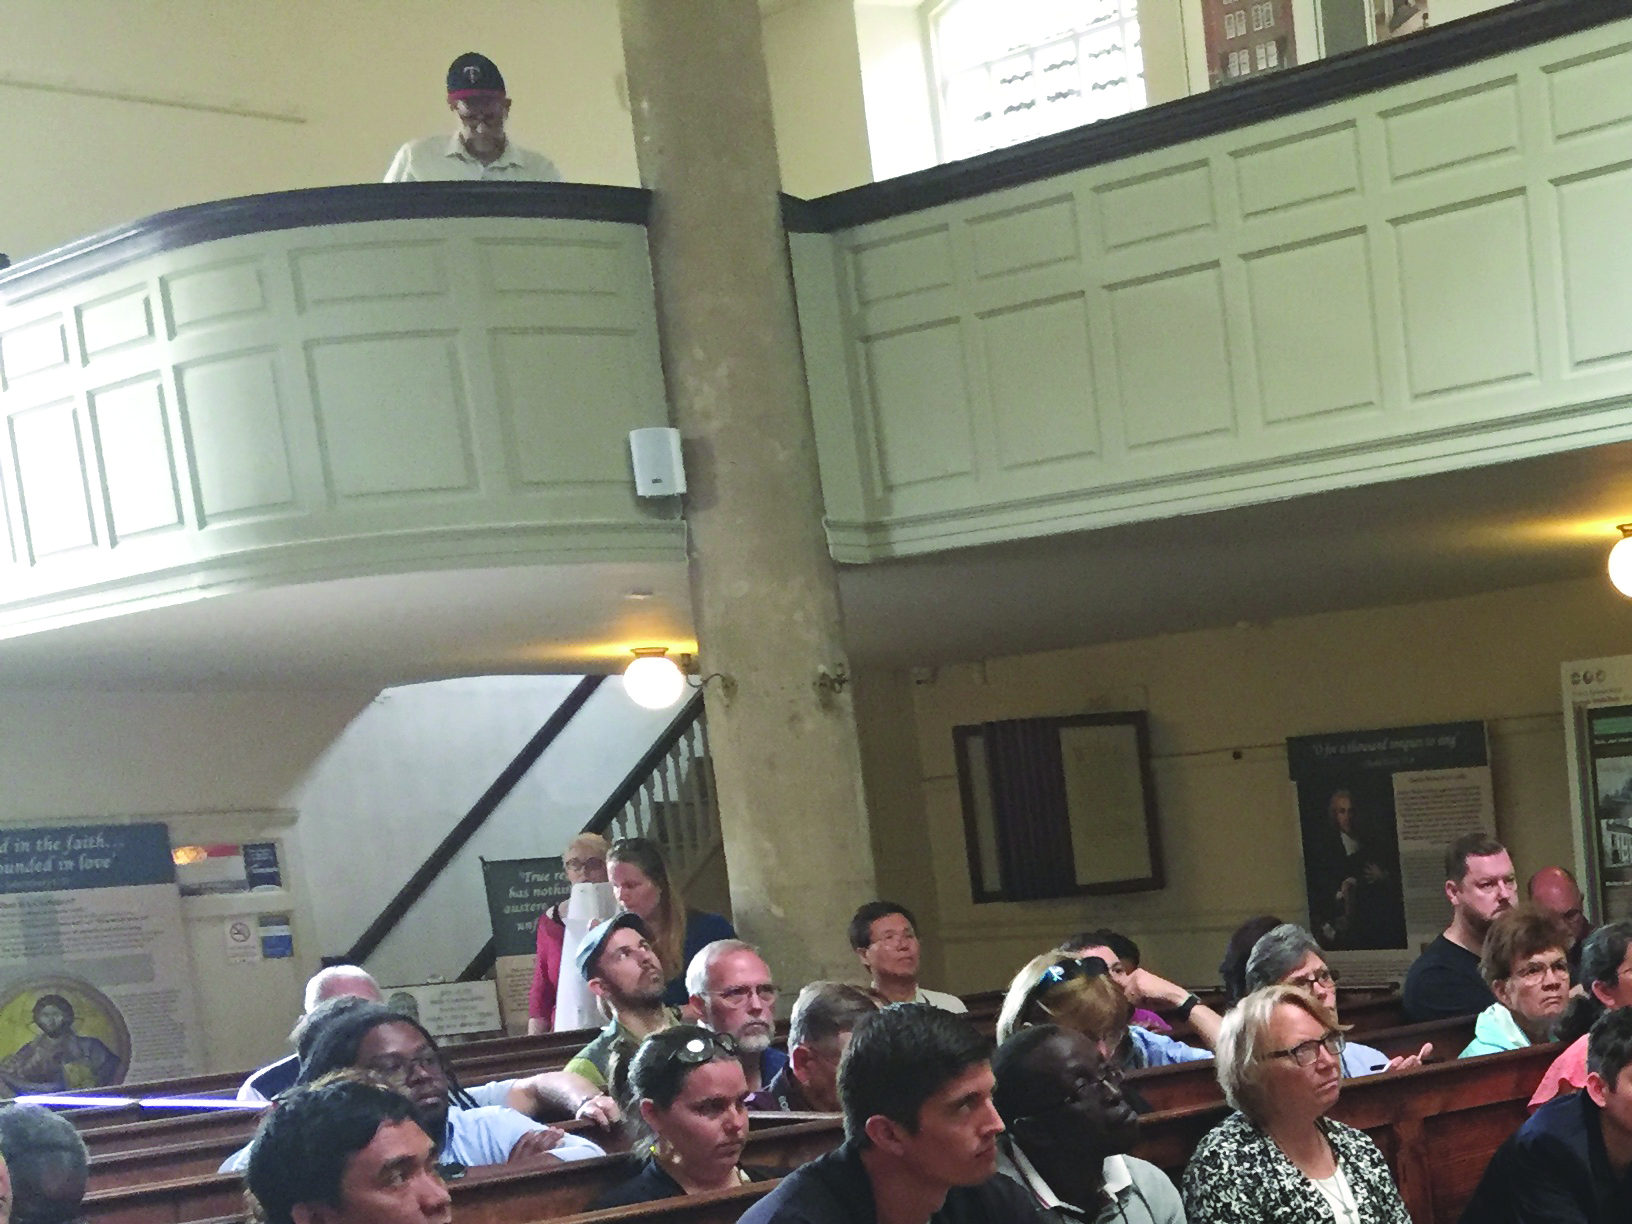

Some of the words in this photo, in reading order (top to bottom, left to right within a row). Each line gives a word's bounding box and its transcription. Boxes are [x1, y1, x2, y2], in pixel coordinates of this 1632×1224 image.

[14, 836, 30, 853] in
[35, 834, 62, 852] the
[58, 859, 75, 872] in
[508, 885, 529, 899] has
